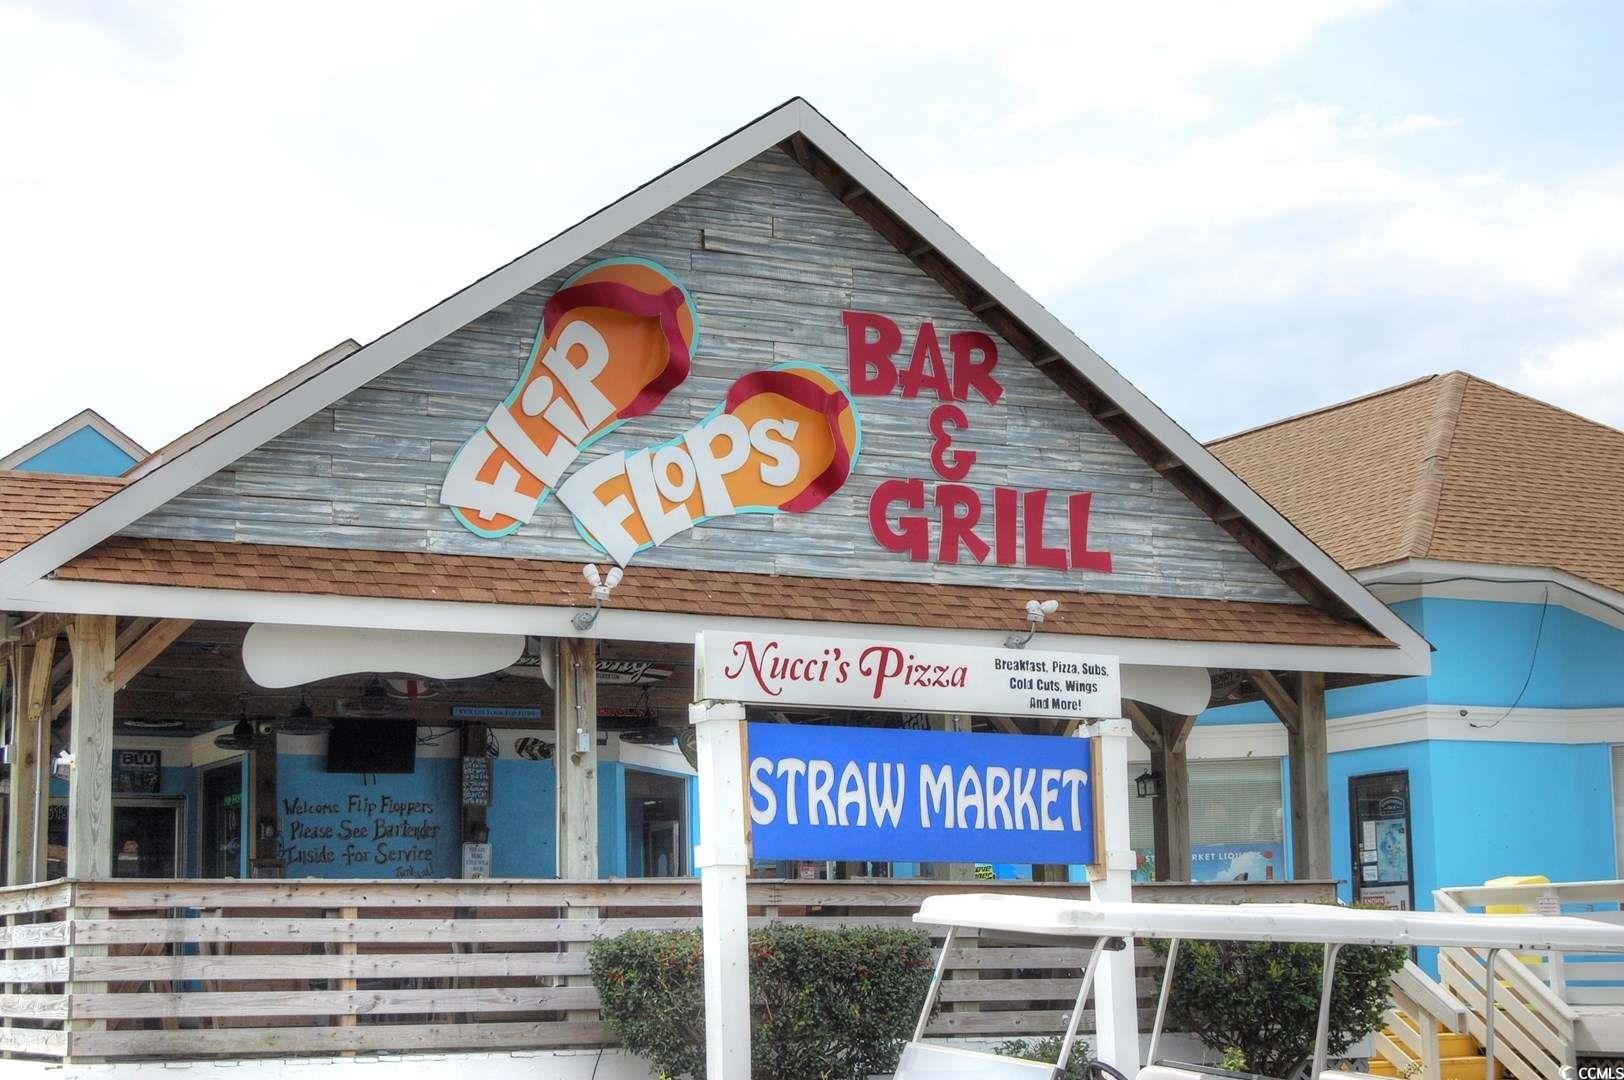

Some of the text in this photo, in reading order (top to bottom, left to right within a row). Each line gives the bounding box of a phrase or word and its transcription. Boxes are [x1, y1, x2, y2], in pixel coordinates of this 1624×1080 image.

[842, 310, 1004, 406] BAR
[928, 403, 977, 480] &
[868, 477, 1112, 573] GRILL
[725, 641, 969, 699] Nucci's Pizza
[1082, 663, 1109, 677] Subs,
[1010, 677, 1098, 694] Cold Cuts, Wings
[1030, 697, 1082, 711] And More!
[284, 794, 434, 816] Welcome Flip Floppers
[750, 756, 1088, 832] STRAW MARKET
[290, 819, 441, 842] Please See Bartender
[286, 845, 335, 866] Inside
[375, 843, 432, 865] Service
[1191, 853, 1216, 862] RKET
